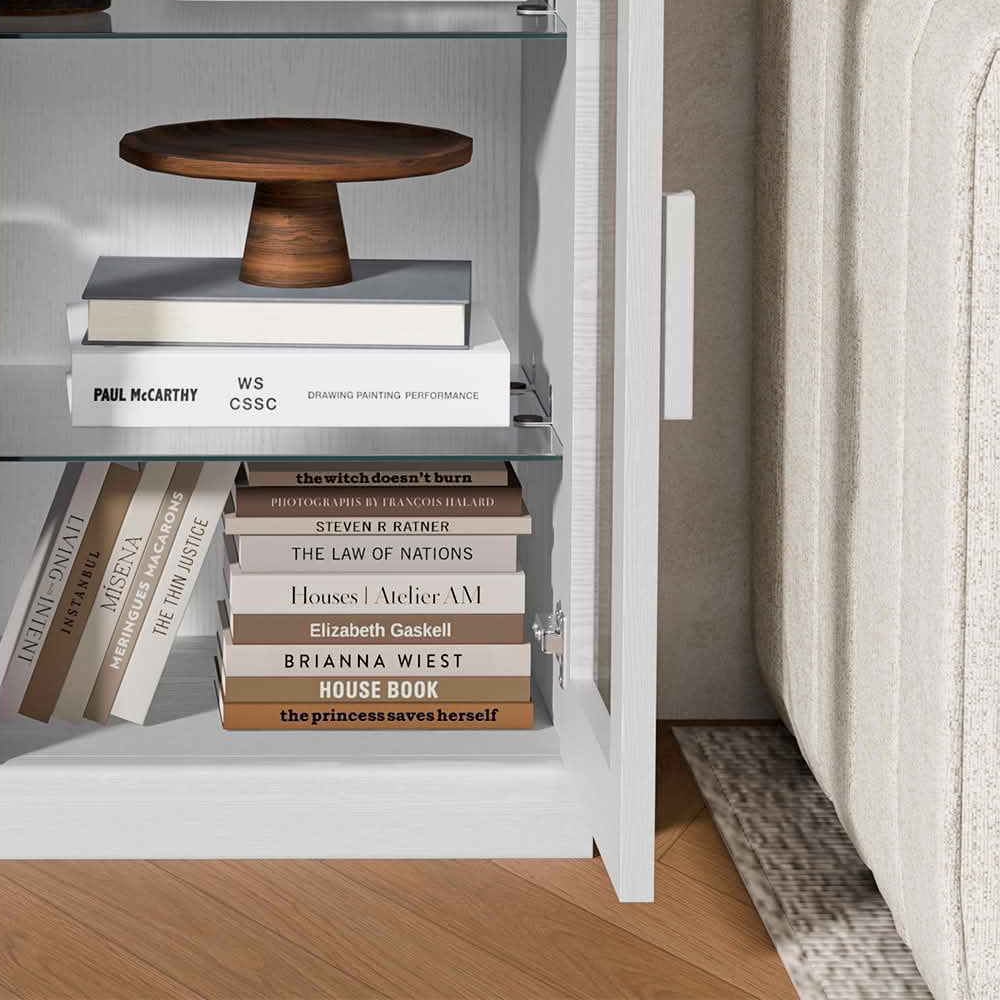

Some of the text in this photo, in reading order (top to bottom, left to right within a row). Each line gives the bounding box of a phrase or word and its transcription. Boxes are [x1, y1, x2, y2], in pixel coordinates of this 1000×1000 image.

[238, 376, 264, 390] WS
[93, 387, 198, 402] PAUL McCARTHY
[307, 390, 479, 401] DRAWING PAINTING PERFORMANCE
[229, 397, 278, 411] CSSC
[434, 472, 472, 484] burn
[271, 497, 362, 507] PHOTOGRAPHS
[365, 497, 379, 507] BY
[445, 497, 495, 507] HALARD
[316, 521, 450, 533] STEVEN R RATNER
[292, 547, 473, 561] THE LAW OF NATIONS
[110, 491, 184, 670] MERINGUES MACARONS
[152, 516, 209, 636] THE THIN JUSTICE
[18, 514, 85, 663] LIVING INTENT
[61, 552, 100, 635] INSTANBUL
[291, 586, 359, 605] Houses
[374, 585, 441, 605] Atelier
[443, 586, 481, 605] AM
[310, 622, 451, 638] Elizabeth Gaskell
[285, 653, 463, 669] BRIANNA WIEST
[319, 681, 439, 699] HOUSE BOOK
[280, 708, 499, 725] the princess saves herself
